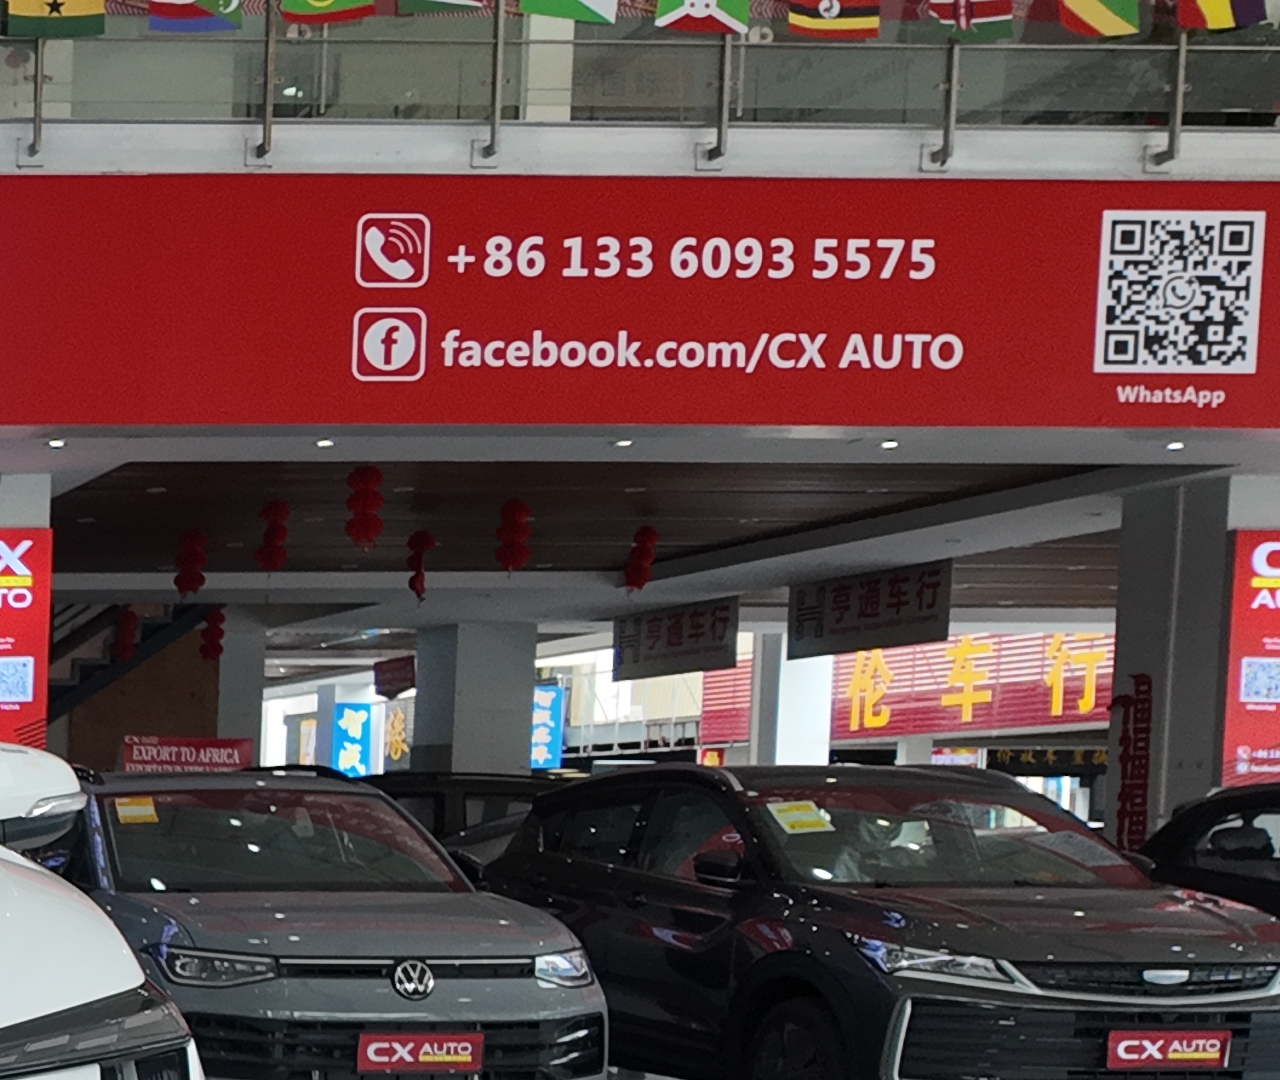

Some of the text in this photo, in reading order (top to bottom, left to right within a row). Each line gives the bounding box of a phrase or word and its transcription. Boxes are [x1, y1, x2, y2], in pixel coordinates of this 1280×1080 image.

[448, 236, 935, 279] +86 133 6093 5575
[441, 329, 963, 373] facebook.com/CX AUTO
[1117, 385, 1225, 408] WhatsApp
[1251, 541, 1280, 577] C
[133, 745, 240, 764] EXPORT TO AFRICA
[366, 1042, 471, 1062] CX AUTO
[1117, 1039, 1220, 1060] CX AUTO
